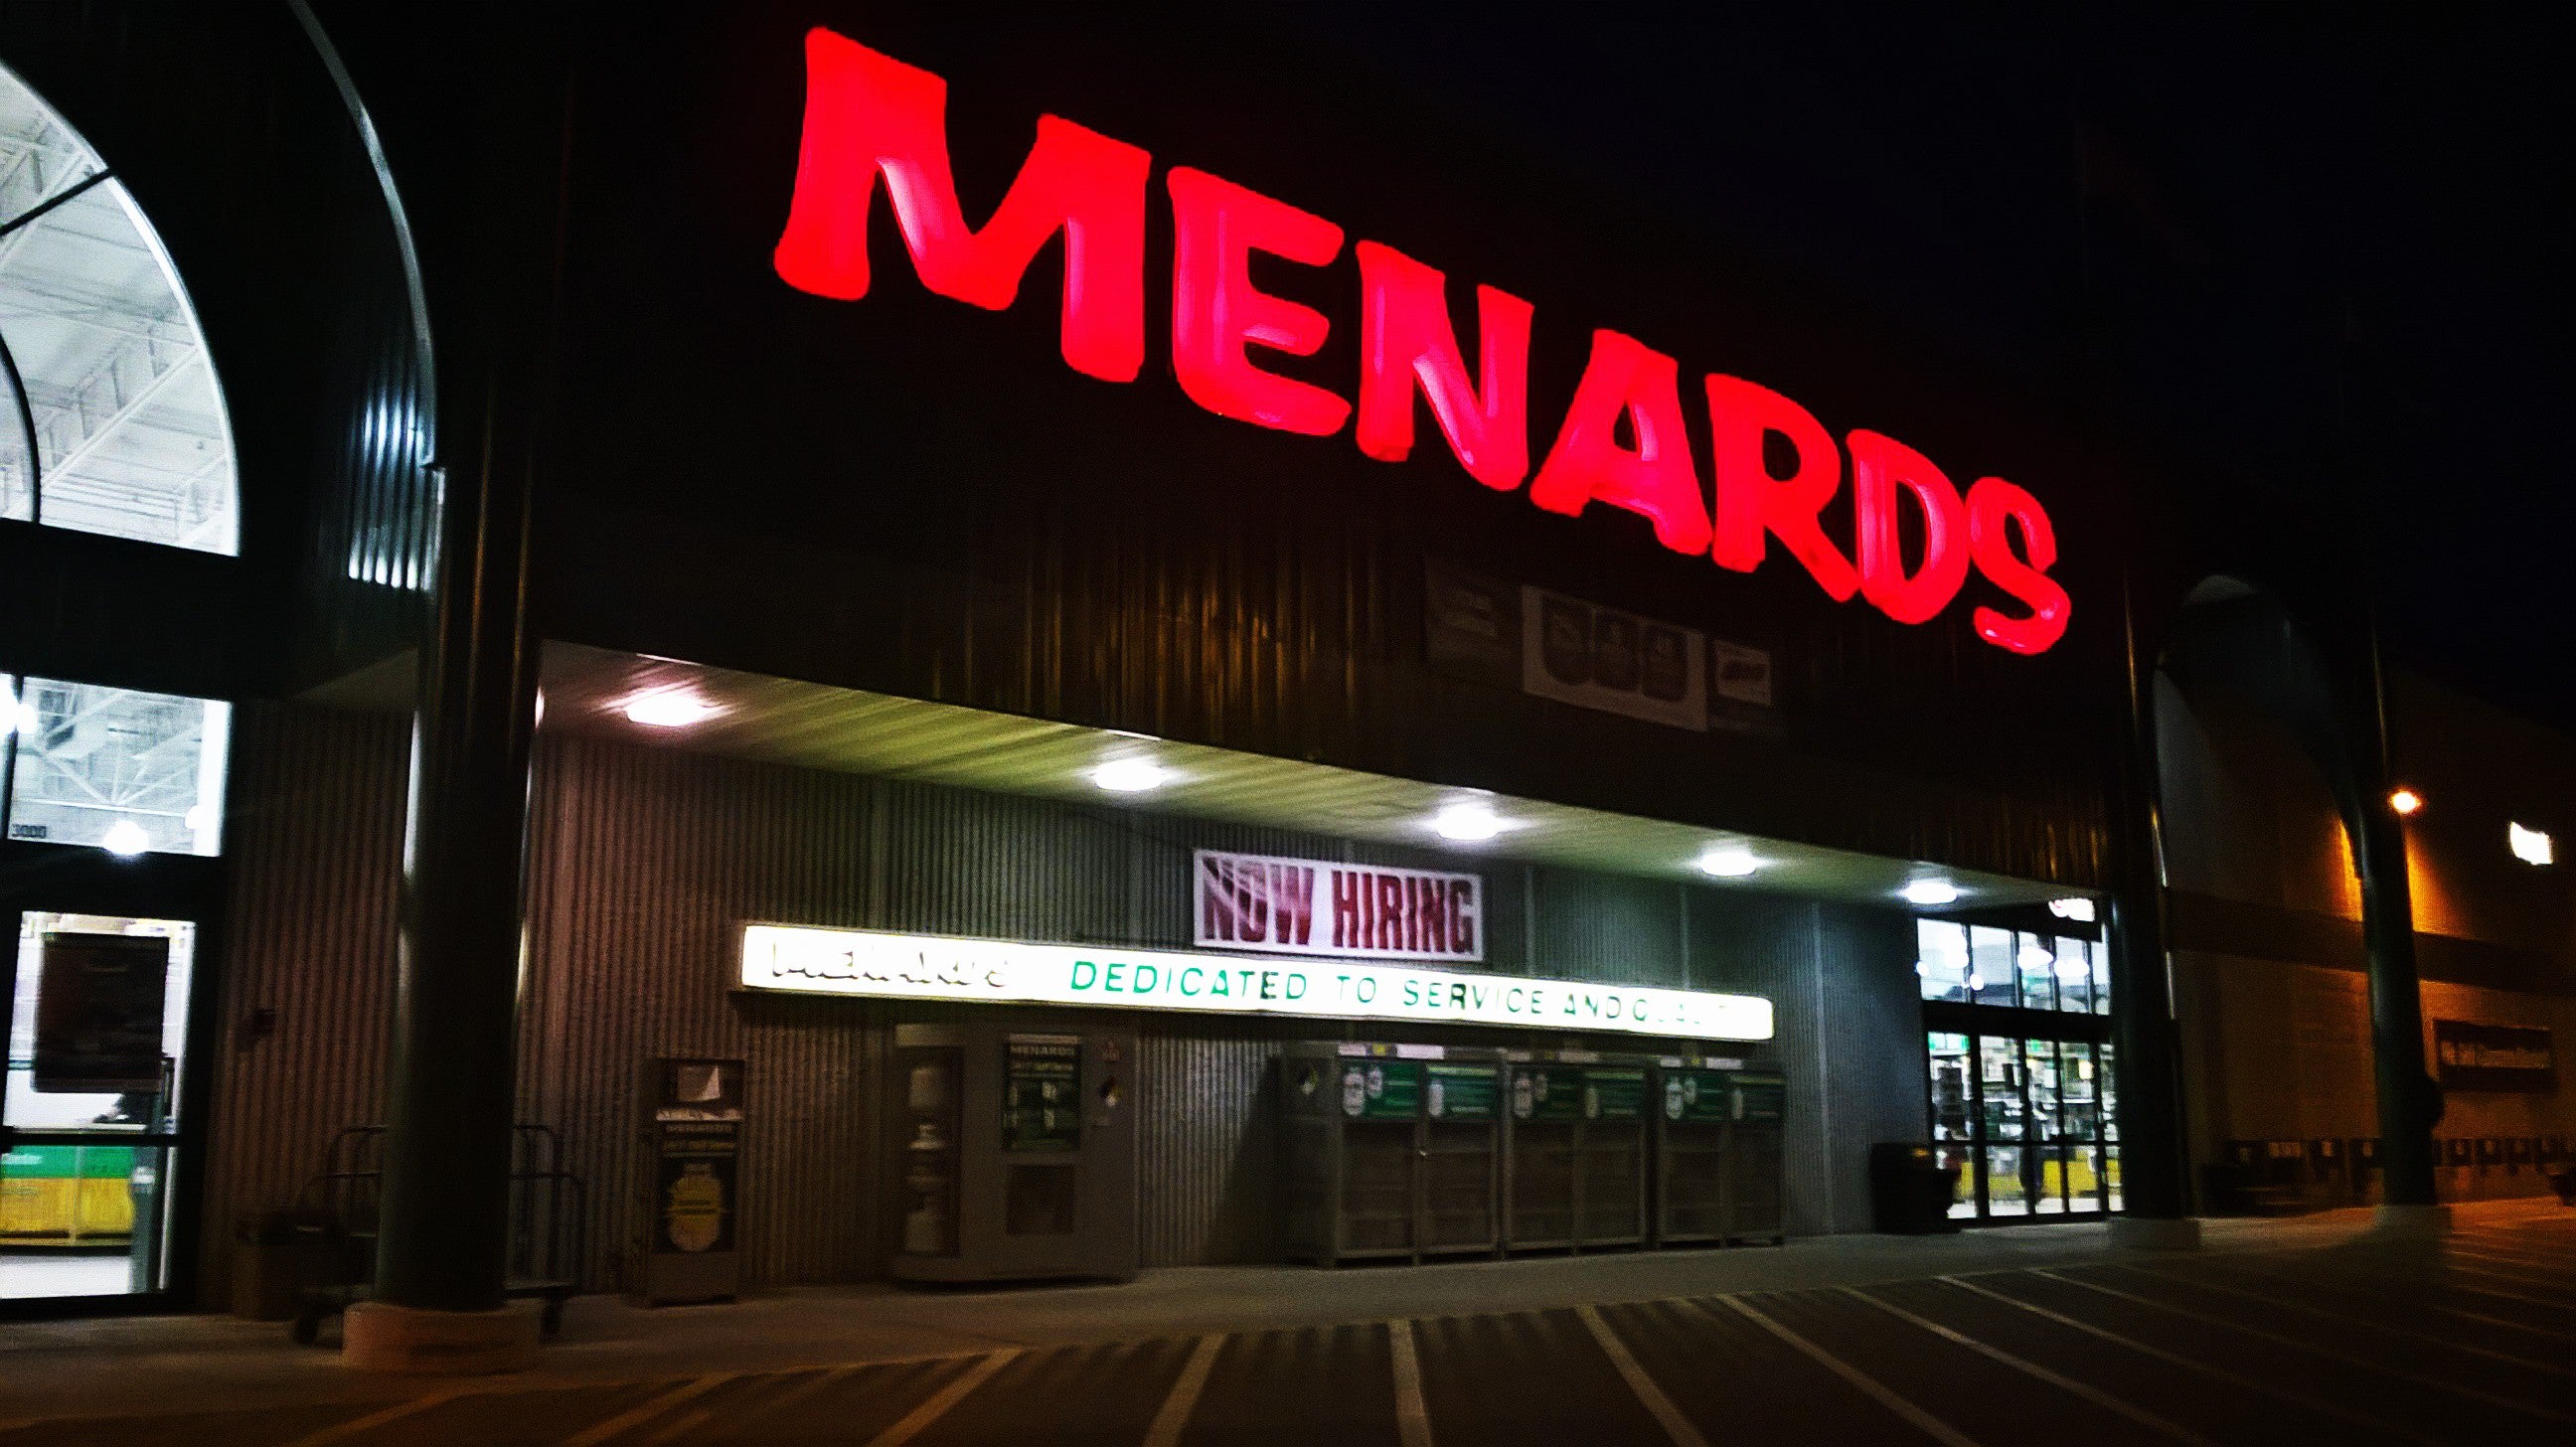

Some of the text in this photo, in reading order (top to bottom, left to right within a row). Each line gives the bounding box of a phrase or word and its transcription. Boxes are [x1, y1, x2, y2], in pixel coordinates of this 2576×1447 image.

[774, 27, 2071, 655] MENARDS
[1202, 856, 1474, 954] NOW HIRING
[1070, 961, 1307, 1000] DEDICATED
[1337, 975, 1376, 1003] TO
[1402, 980, 1543, 1014] SERVICE
[1563, 993, 1622, 1020] AND
